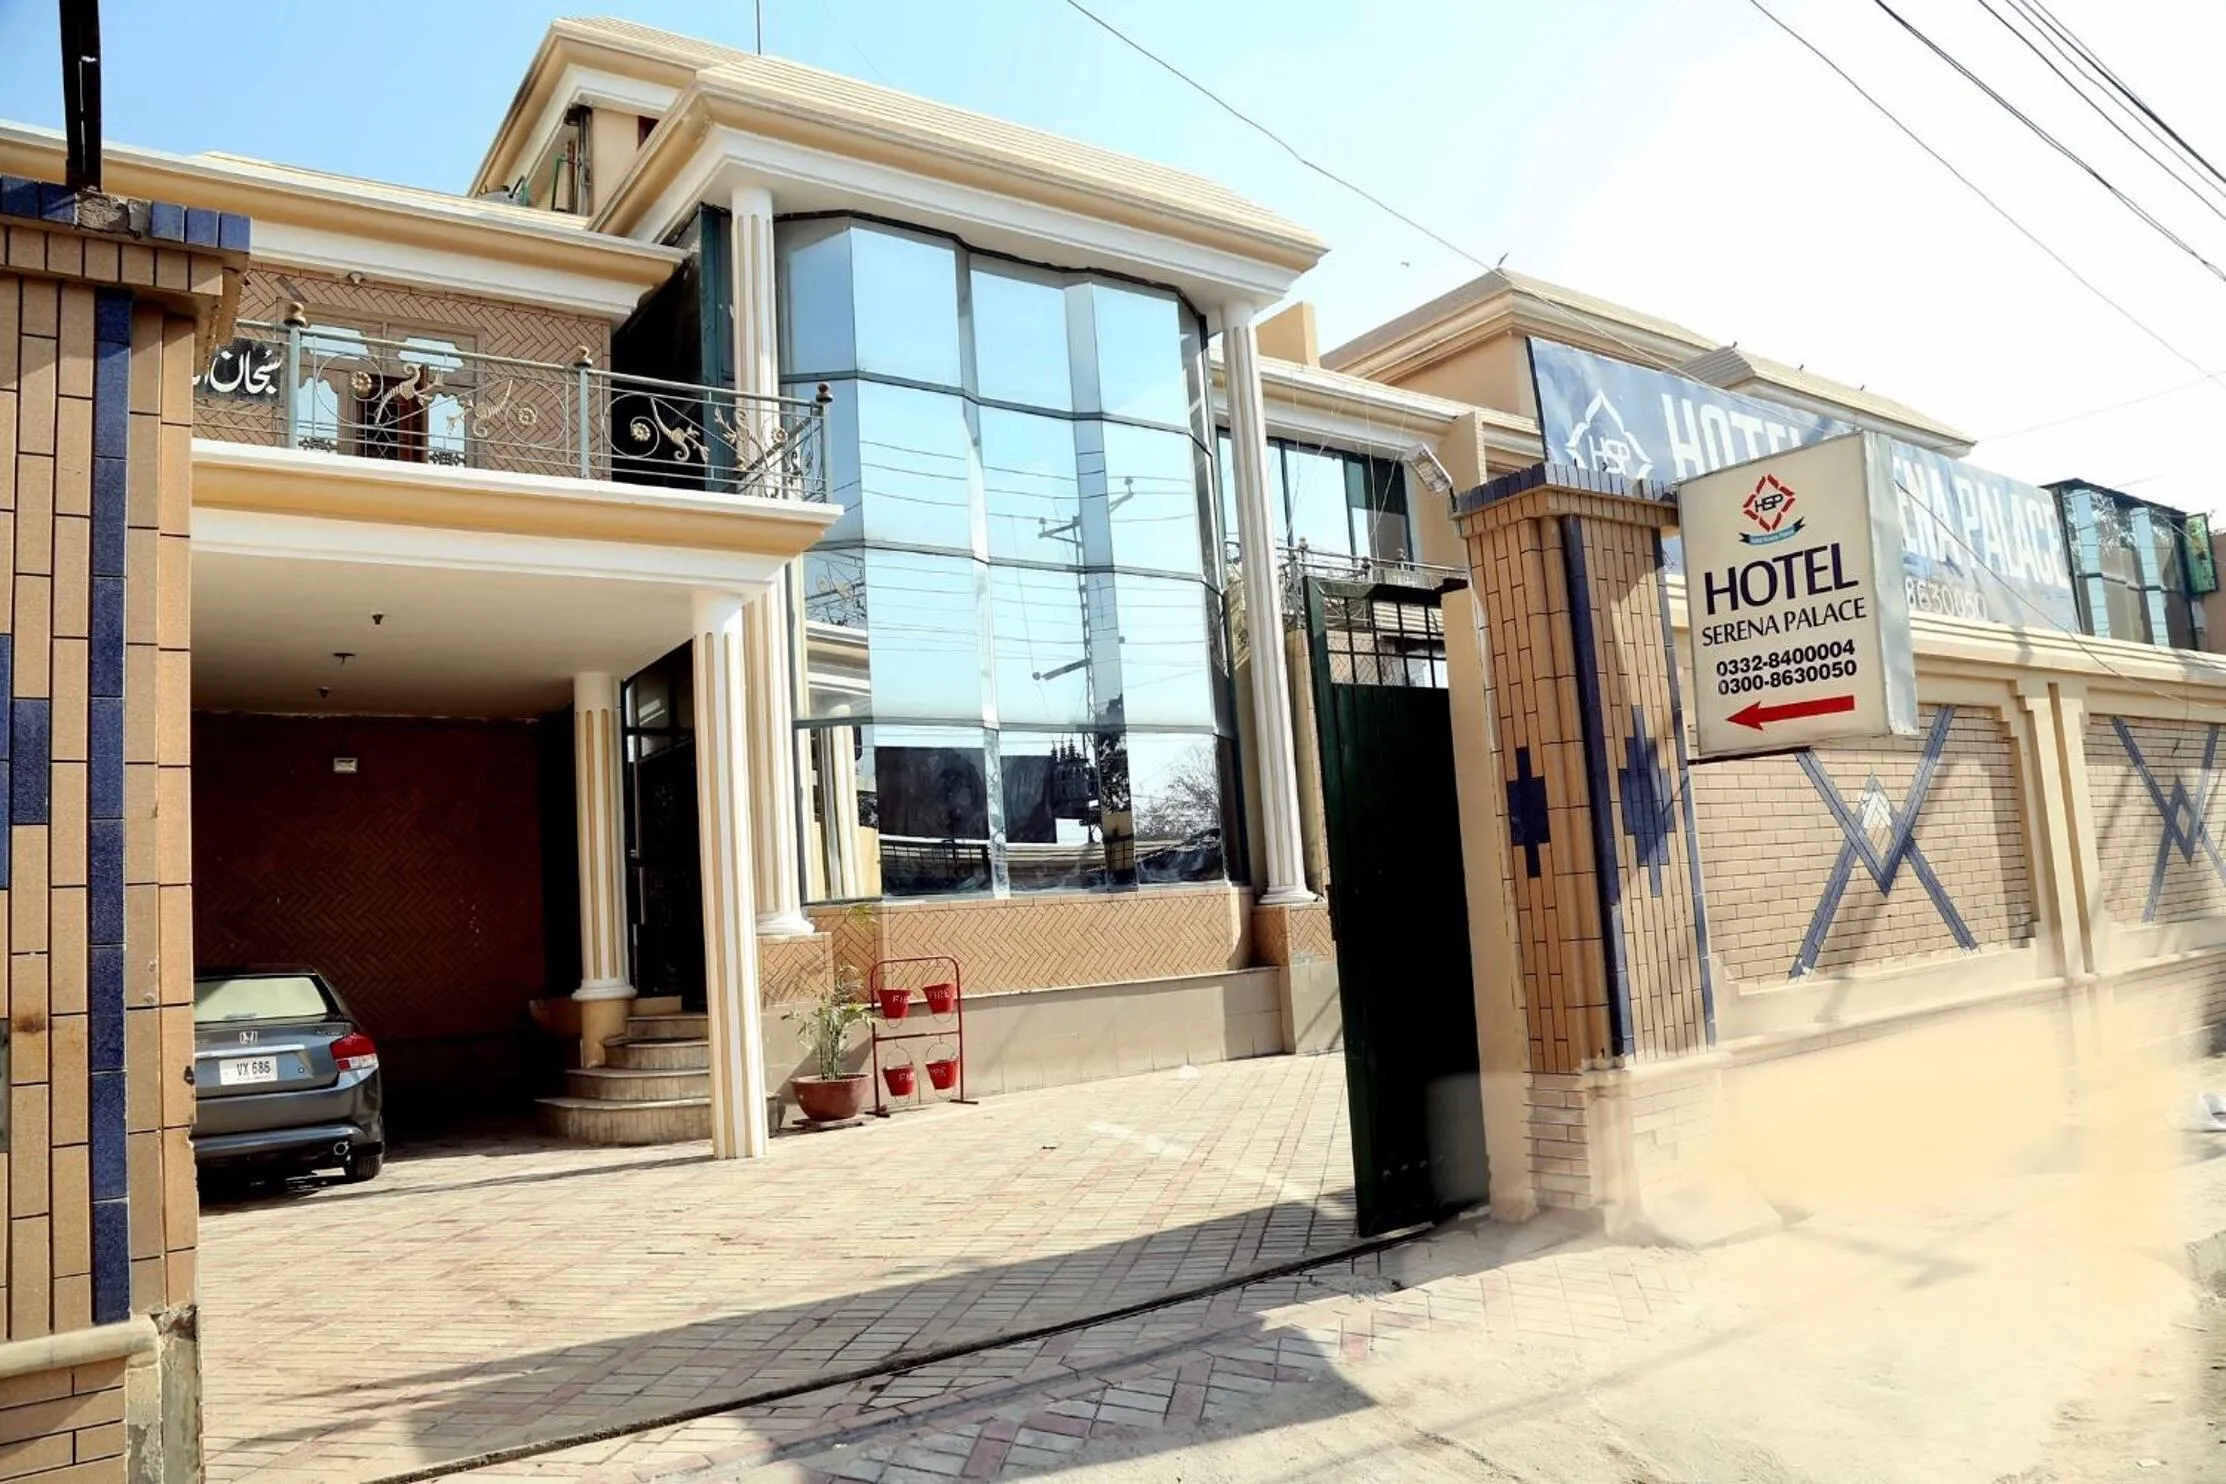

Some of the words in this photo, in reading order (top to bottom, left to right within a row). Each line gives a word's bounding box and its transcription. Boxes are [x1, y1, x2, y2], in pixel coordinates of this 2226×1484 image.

[1754, 493, 1784, 513] HSP
[1704, 542, 1859, 616] HOTEL
[1701, 614, 1780, 647] SERENA
[1783, 597, 1867, 633] PALACE
[1716, 638, 1856, 677] 0332-8400004
[1718, 659, 1858, 695] 0300-8630050
[236, 1061, 249, 1076] VX
